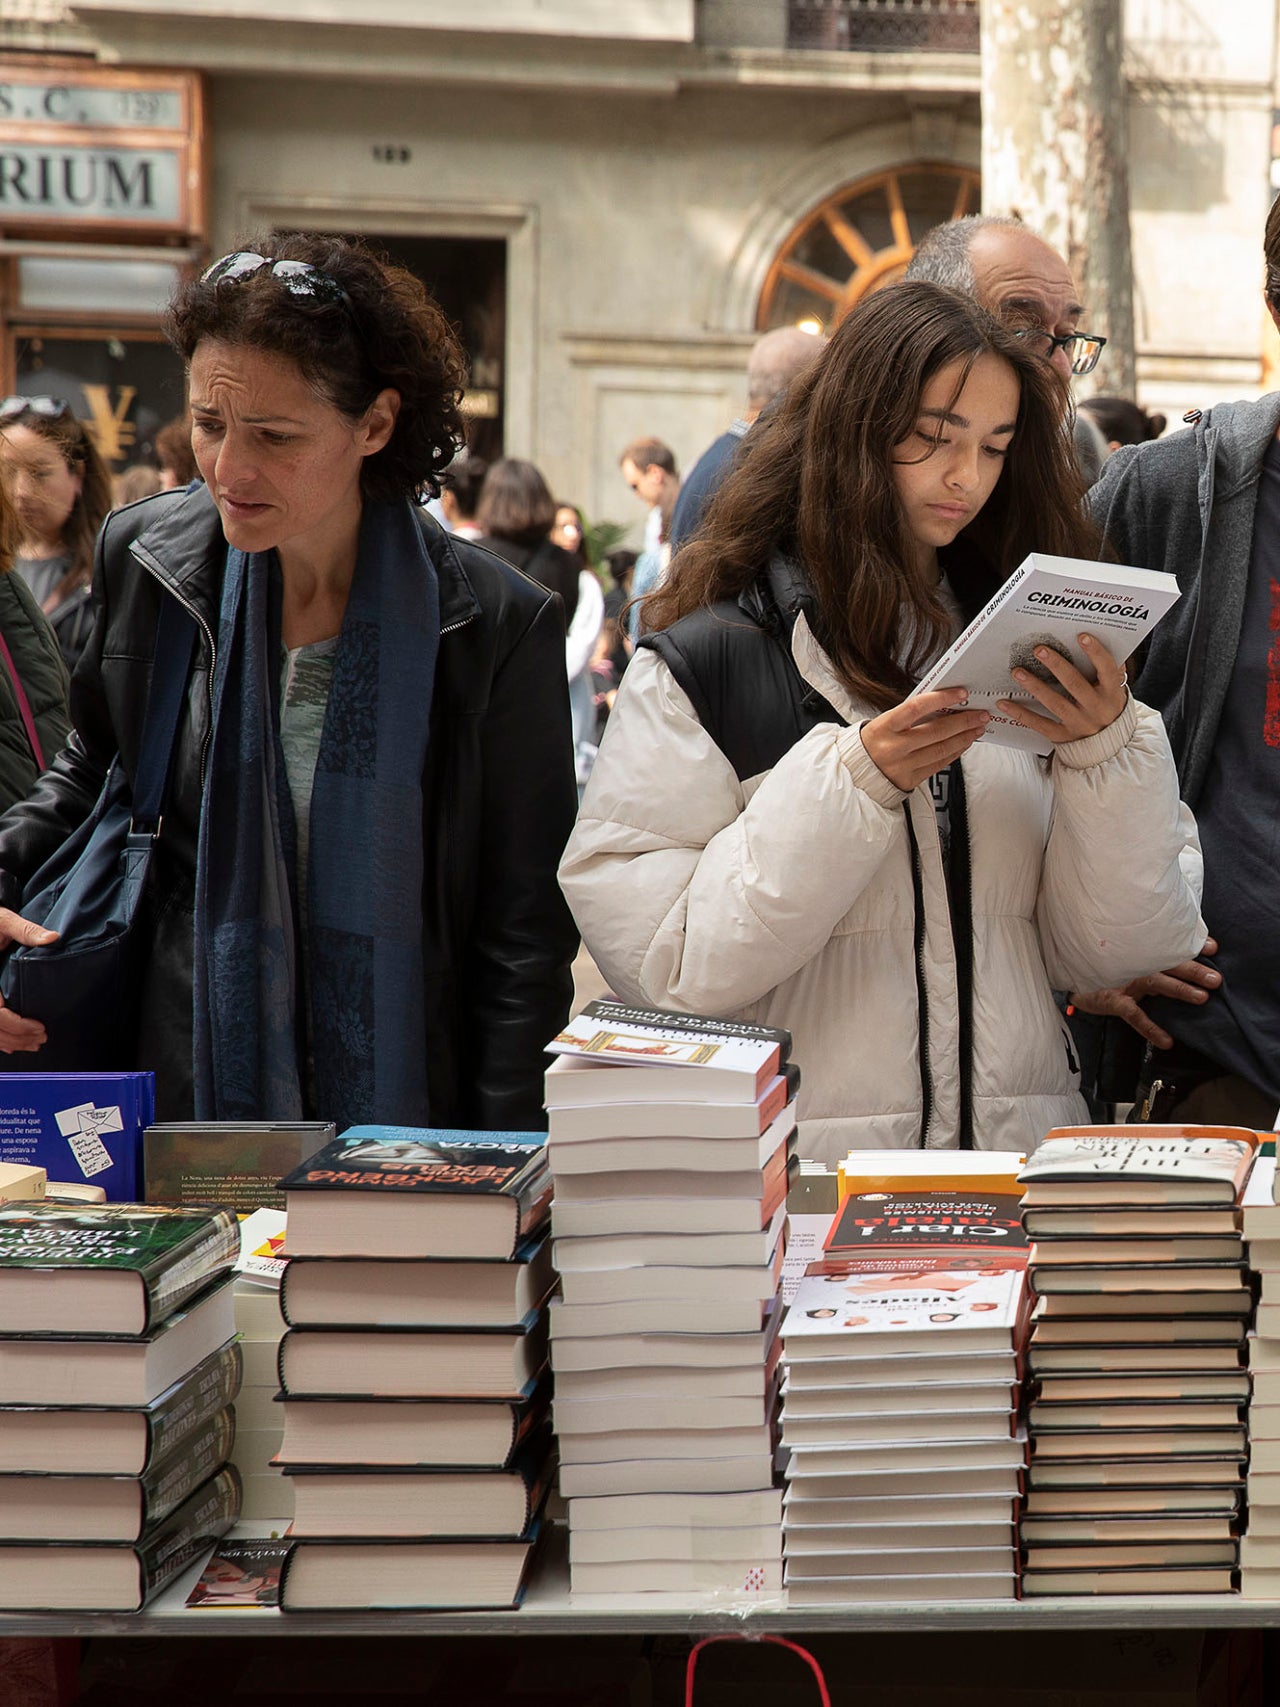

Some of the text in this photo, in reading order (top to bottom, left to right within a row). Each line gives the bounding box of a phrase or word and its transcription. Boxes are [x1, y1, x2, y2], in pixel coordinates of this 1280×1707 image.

[0, 153, 155, 208] RIUM
[986, 568, 1025, 616] CRIMINOLOGÍA
[1027, 591, 1149, 620] CRIMINOLOGÍA
[1063, 587, 1093, 598] MANUAL
[1094, 591, 1123, 602] BÁSICO
[861, 1225, 1009, 1236] Clar i
